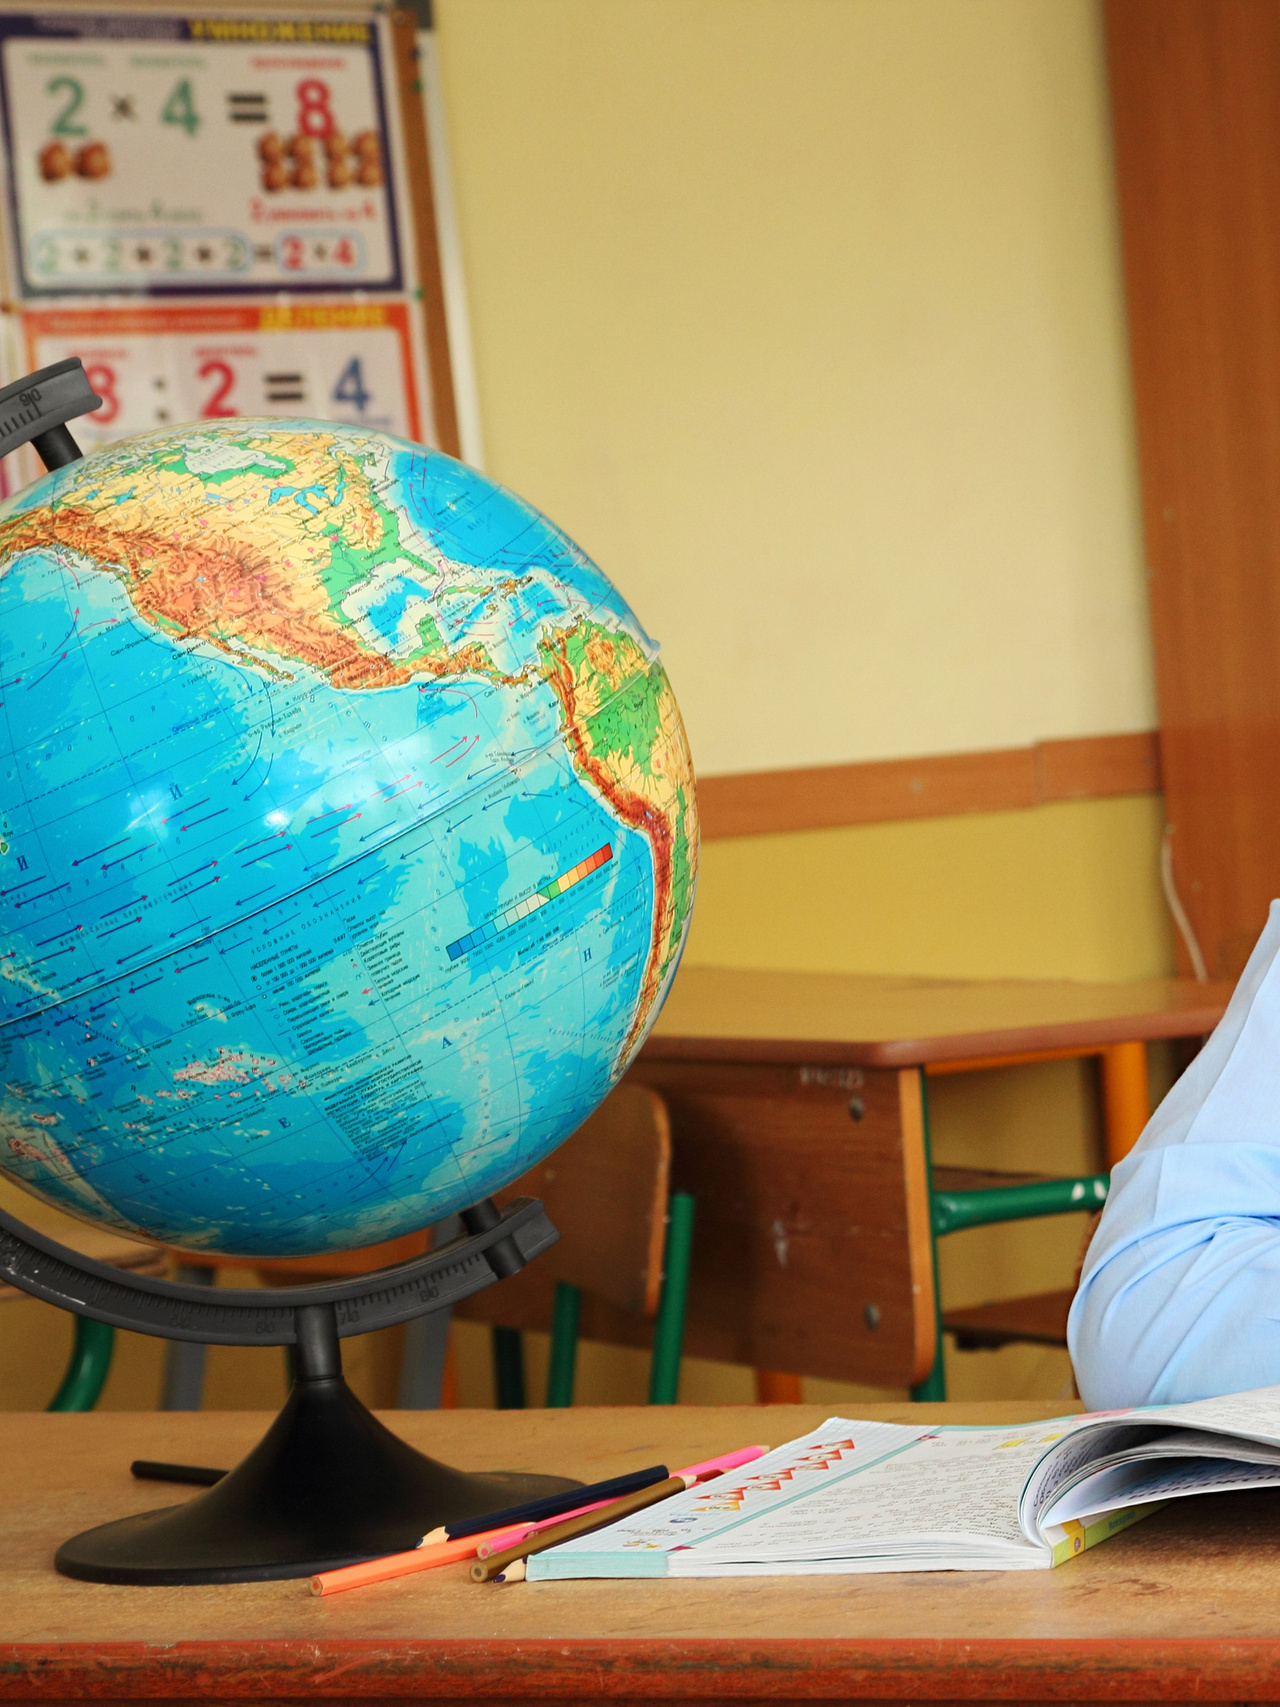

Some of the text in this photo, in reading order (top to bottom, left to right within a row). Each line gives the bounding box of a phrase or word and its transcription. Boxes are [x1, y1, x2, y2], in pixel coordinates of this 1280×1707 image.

[46, 77, 87, 137] 2
[161, 77, 201, 138] 4
[295, 78, 335, 138] 8
[282, 238, 304, 270] 2
[331, 238, 355, 266] 4
[198, 360, 238, 417] 2
[334, 355, 370, 414] 4
